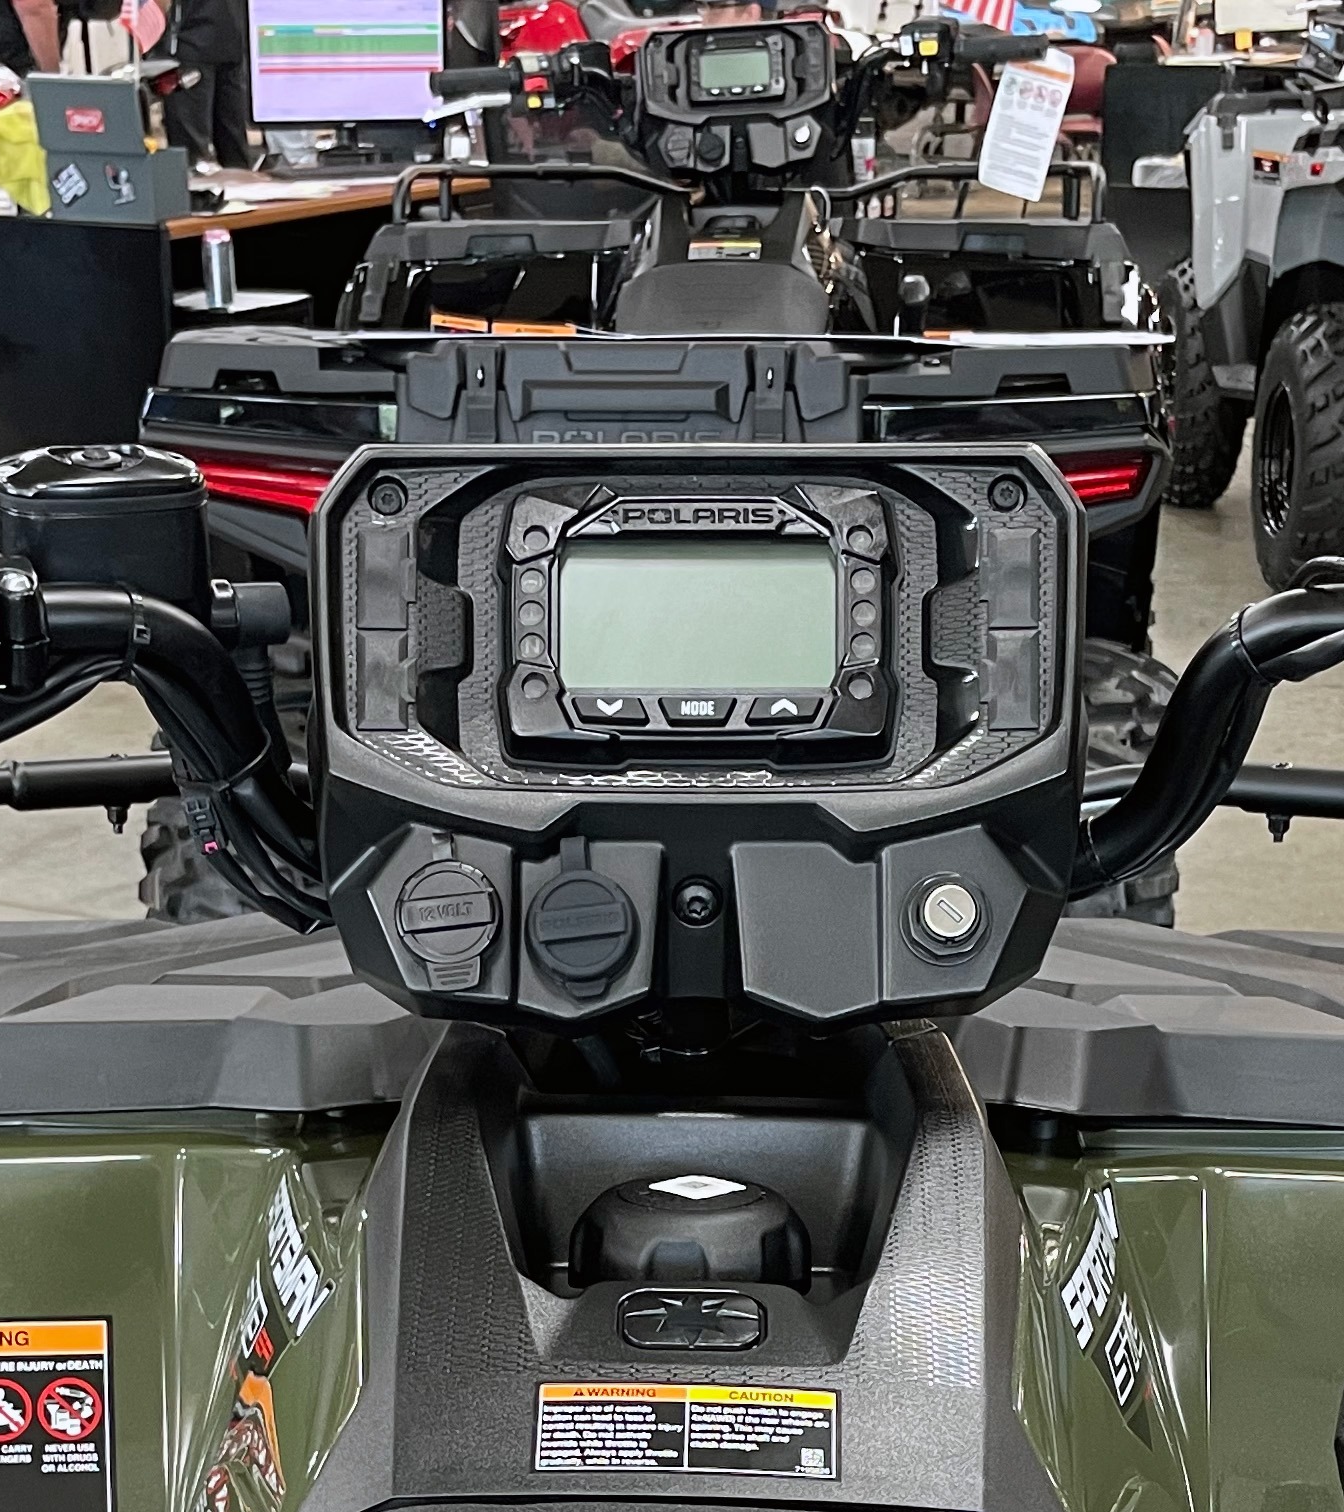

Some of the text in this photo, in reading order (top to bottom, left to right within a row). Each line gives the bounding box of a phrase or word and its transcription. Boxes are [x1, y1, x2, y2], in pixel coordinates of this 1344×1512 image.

[622, 508, 774, 524] POLARIS
[681, 701, 715, 716] MODE
[419, 902, 473, 921] 12 VOLT
[17, 1361, 55, 1372] INJURY
[67, 1360, 103, 1371] DEATH
[587, 1388, 656, 1398] WARNING
[728, 1391, 794, 1402] CAUTION
